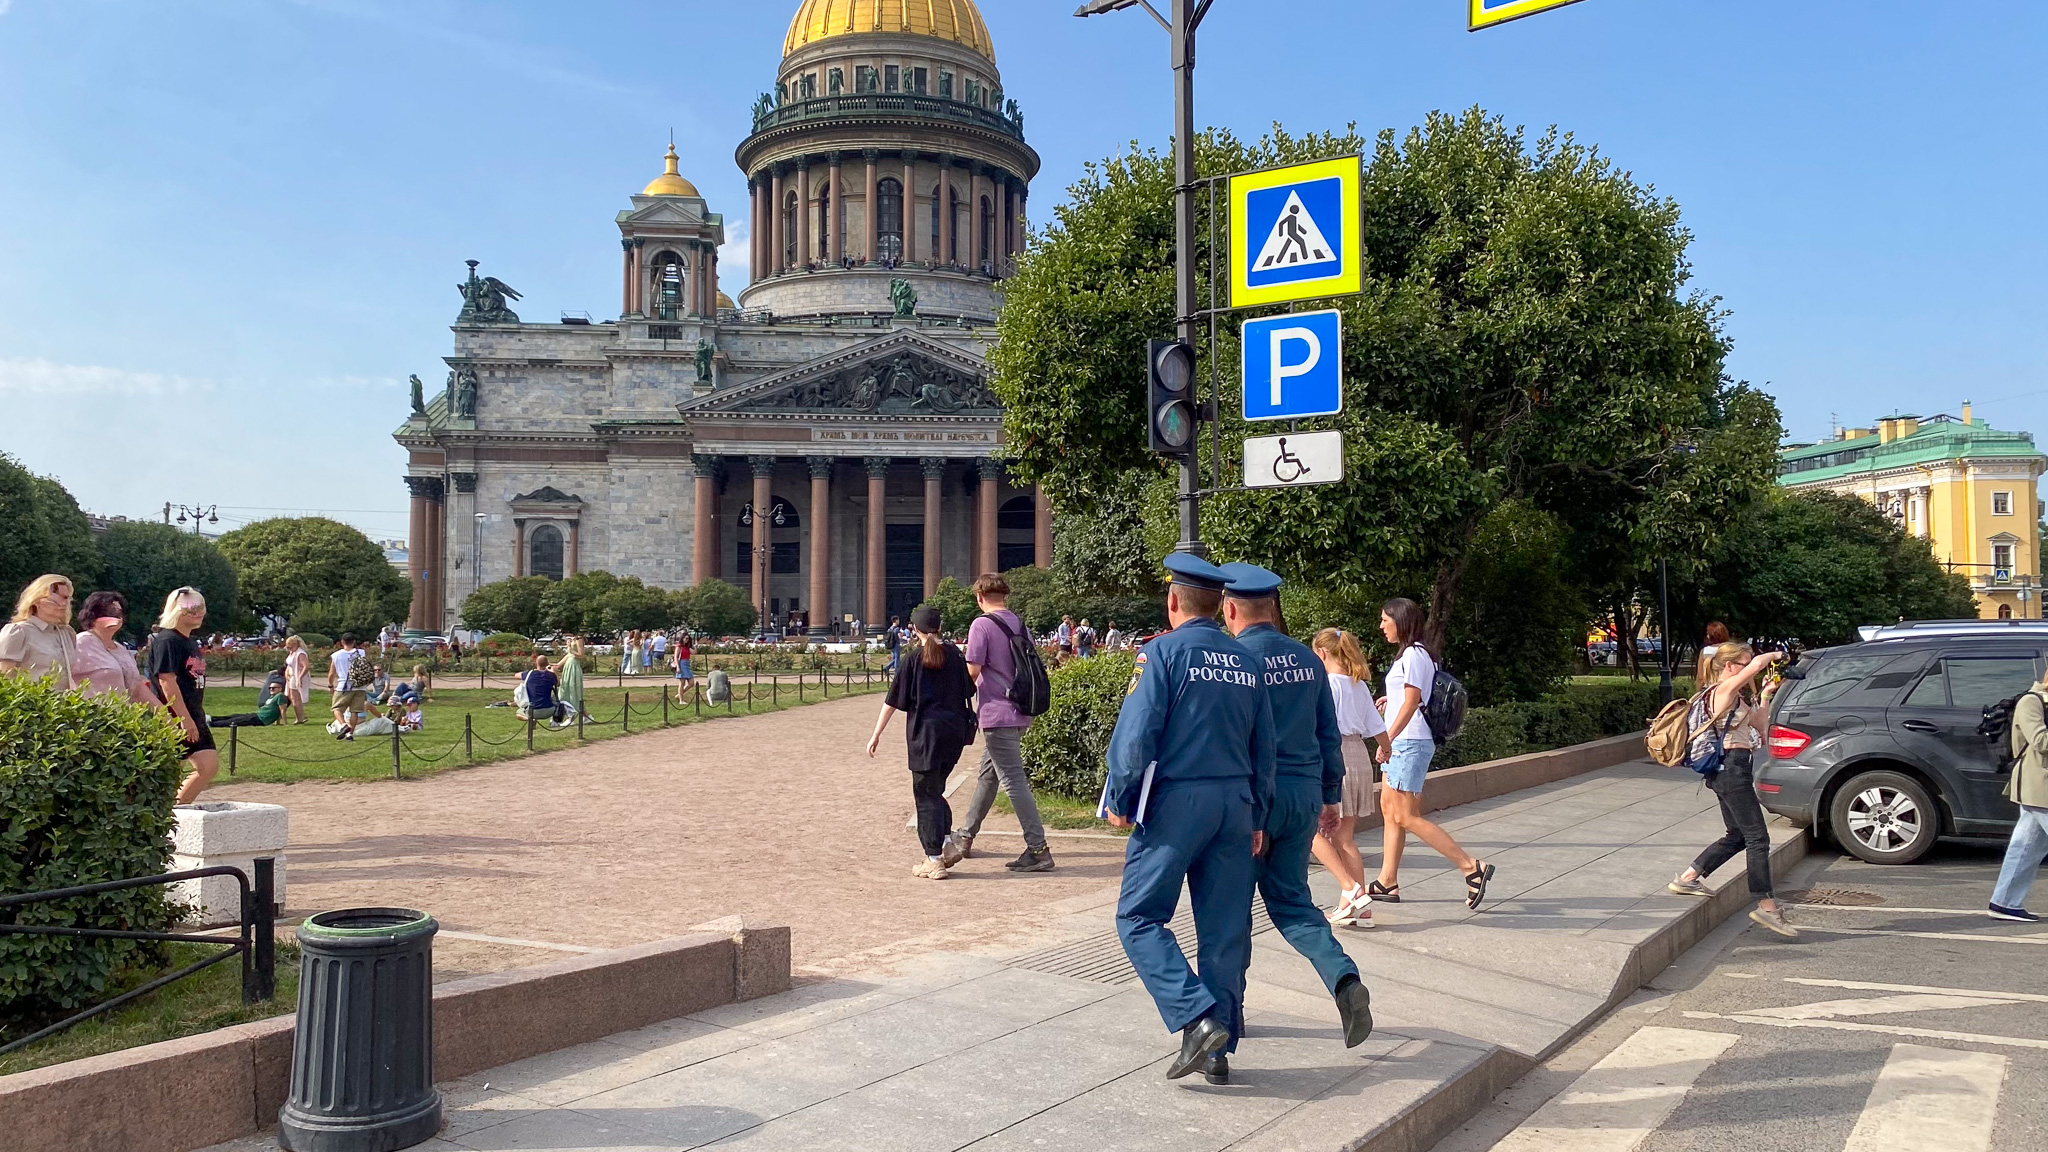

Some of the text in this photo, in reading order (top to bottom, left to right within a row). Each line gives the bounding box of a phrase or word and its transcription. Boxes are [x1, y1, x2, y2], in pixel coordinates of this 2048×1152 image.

[1270, 326, 1321, 406] P
[820, 431, 846, 440] ХРАМЪ
[873, 432, 899, 440] ХРАМЪ
[1201, 650, 1242, 668] МЧС
[1263, 653, 1299, 670] МЧС
[1263, 667, 1315, 686] ОССИИ
